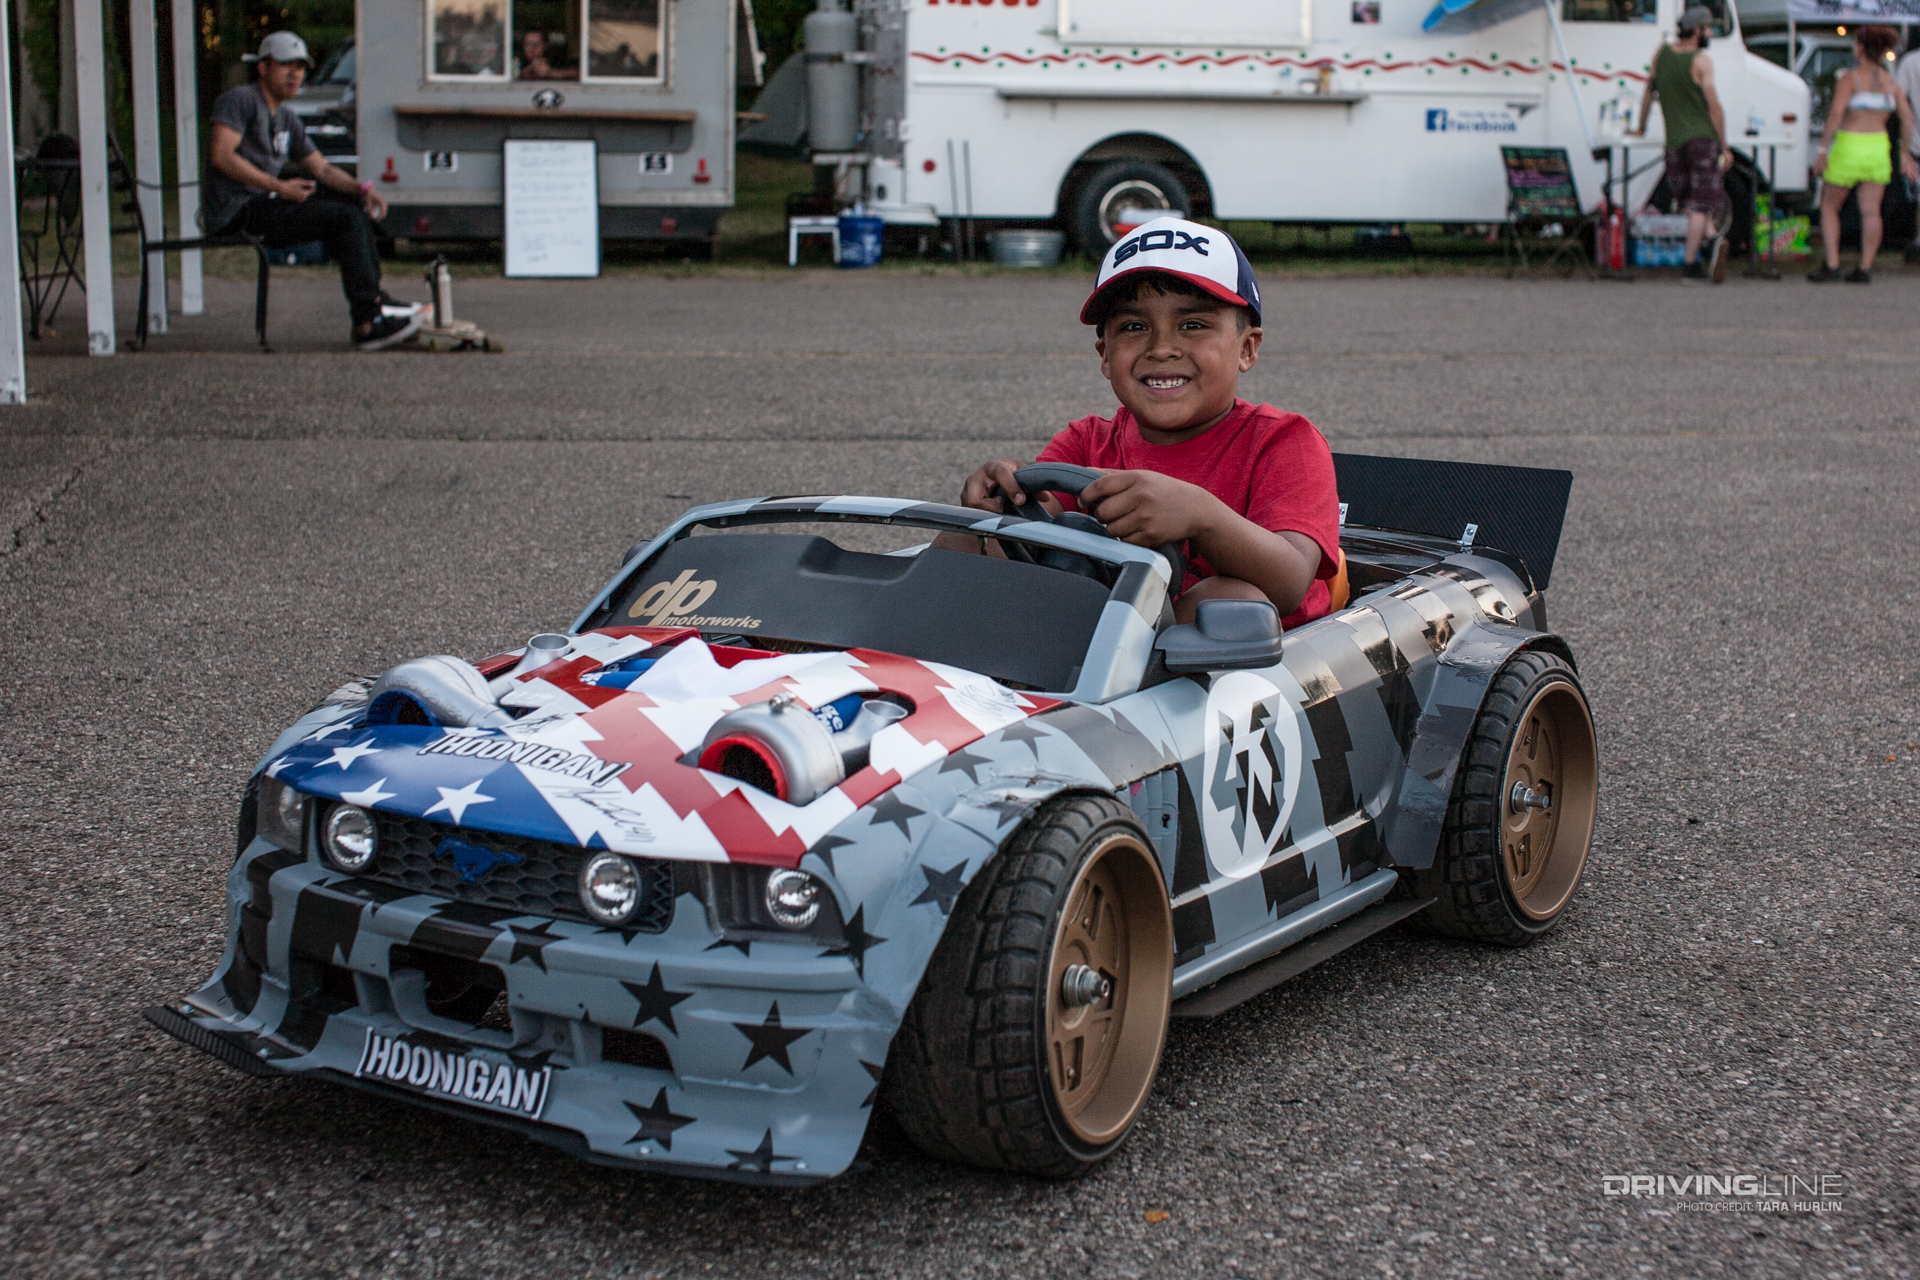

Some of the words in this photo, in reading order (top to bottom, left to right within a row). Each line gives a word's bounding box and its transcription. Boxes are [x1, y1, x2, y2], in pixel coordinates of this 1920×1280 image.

[1113, 230, 1210, 268] SOX
[628, 569, 718, 626] dp
[660, 614, 763, 629] motorworks
